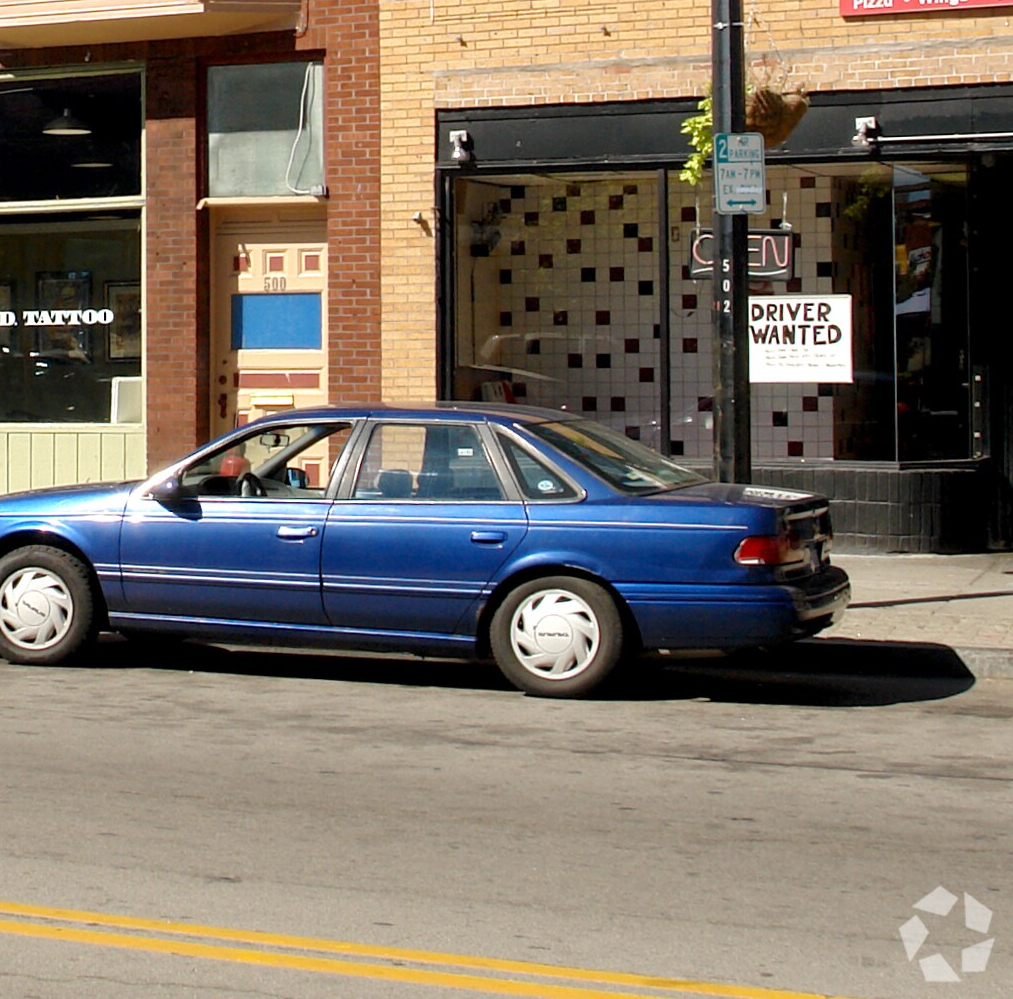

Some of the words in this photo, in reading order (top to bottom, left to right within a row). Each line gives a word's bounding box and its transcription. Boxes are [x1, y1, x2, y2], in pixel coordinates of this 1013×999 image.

[719, 139, 727, 159] 2
[264, 277, 286, 291] 500
[23, 309, 114, 326] TATTOO
[751, 302, 831, 322] DRIVER
[749, 324, 842, 345] WANTED
